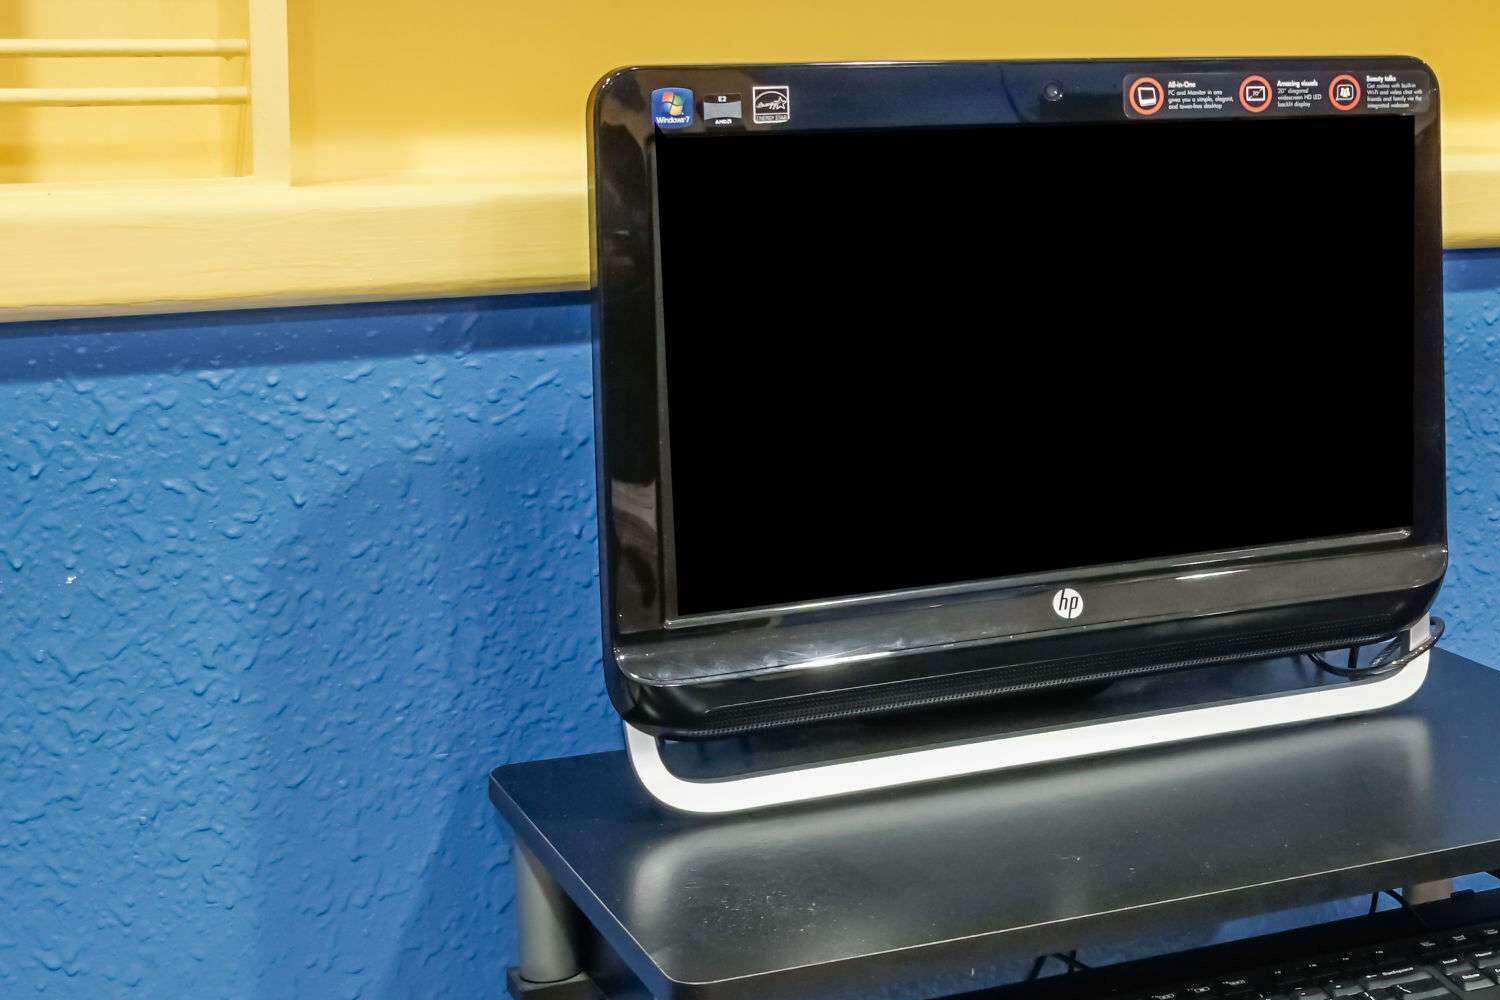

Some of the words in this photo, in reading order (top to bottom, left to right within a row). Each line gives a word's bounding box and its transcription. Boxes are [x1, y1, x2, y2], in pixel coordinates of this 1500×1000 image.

[1168, 80, 1197, 88] All-in-One
[1277, 80, 1300, 88] Amazing
[1301, 79, 1319, 87] visuals
[656, 116, 684, 124] Windows
[1059, 588, 1079, 619] hp
